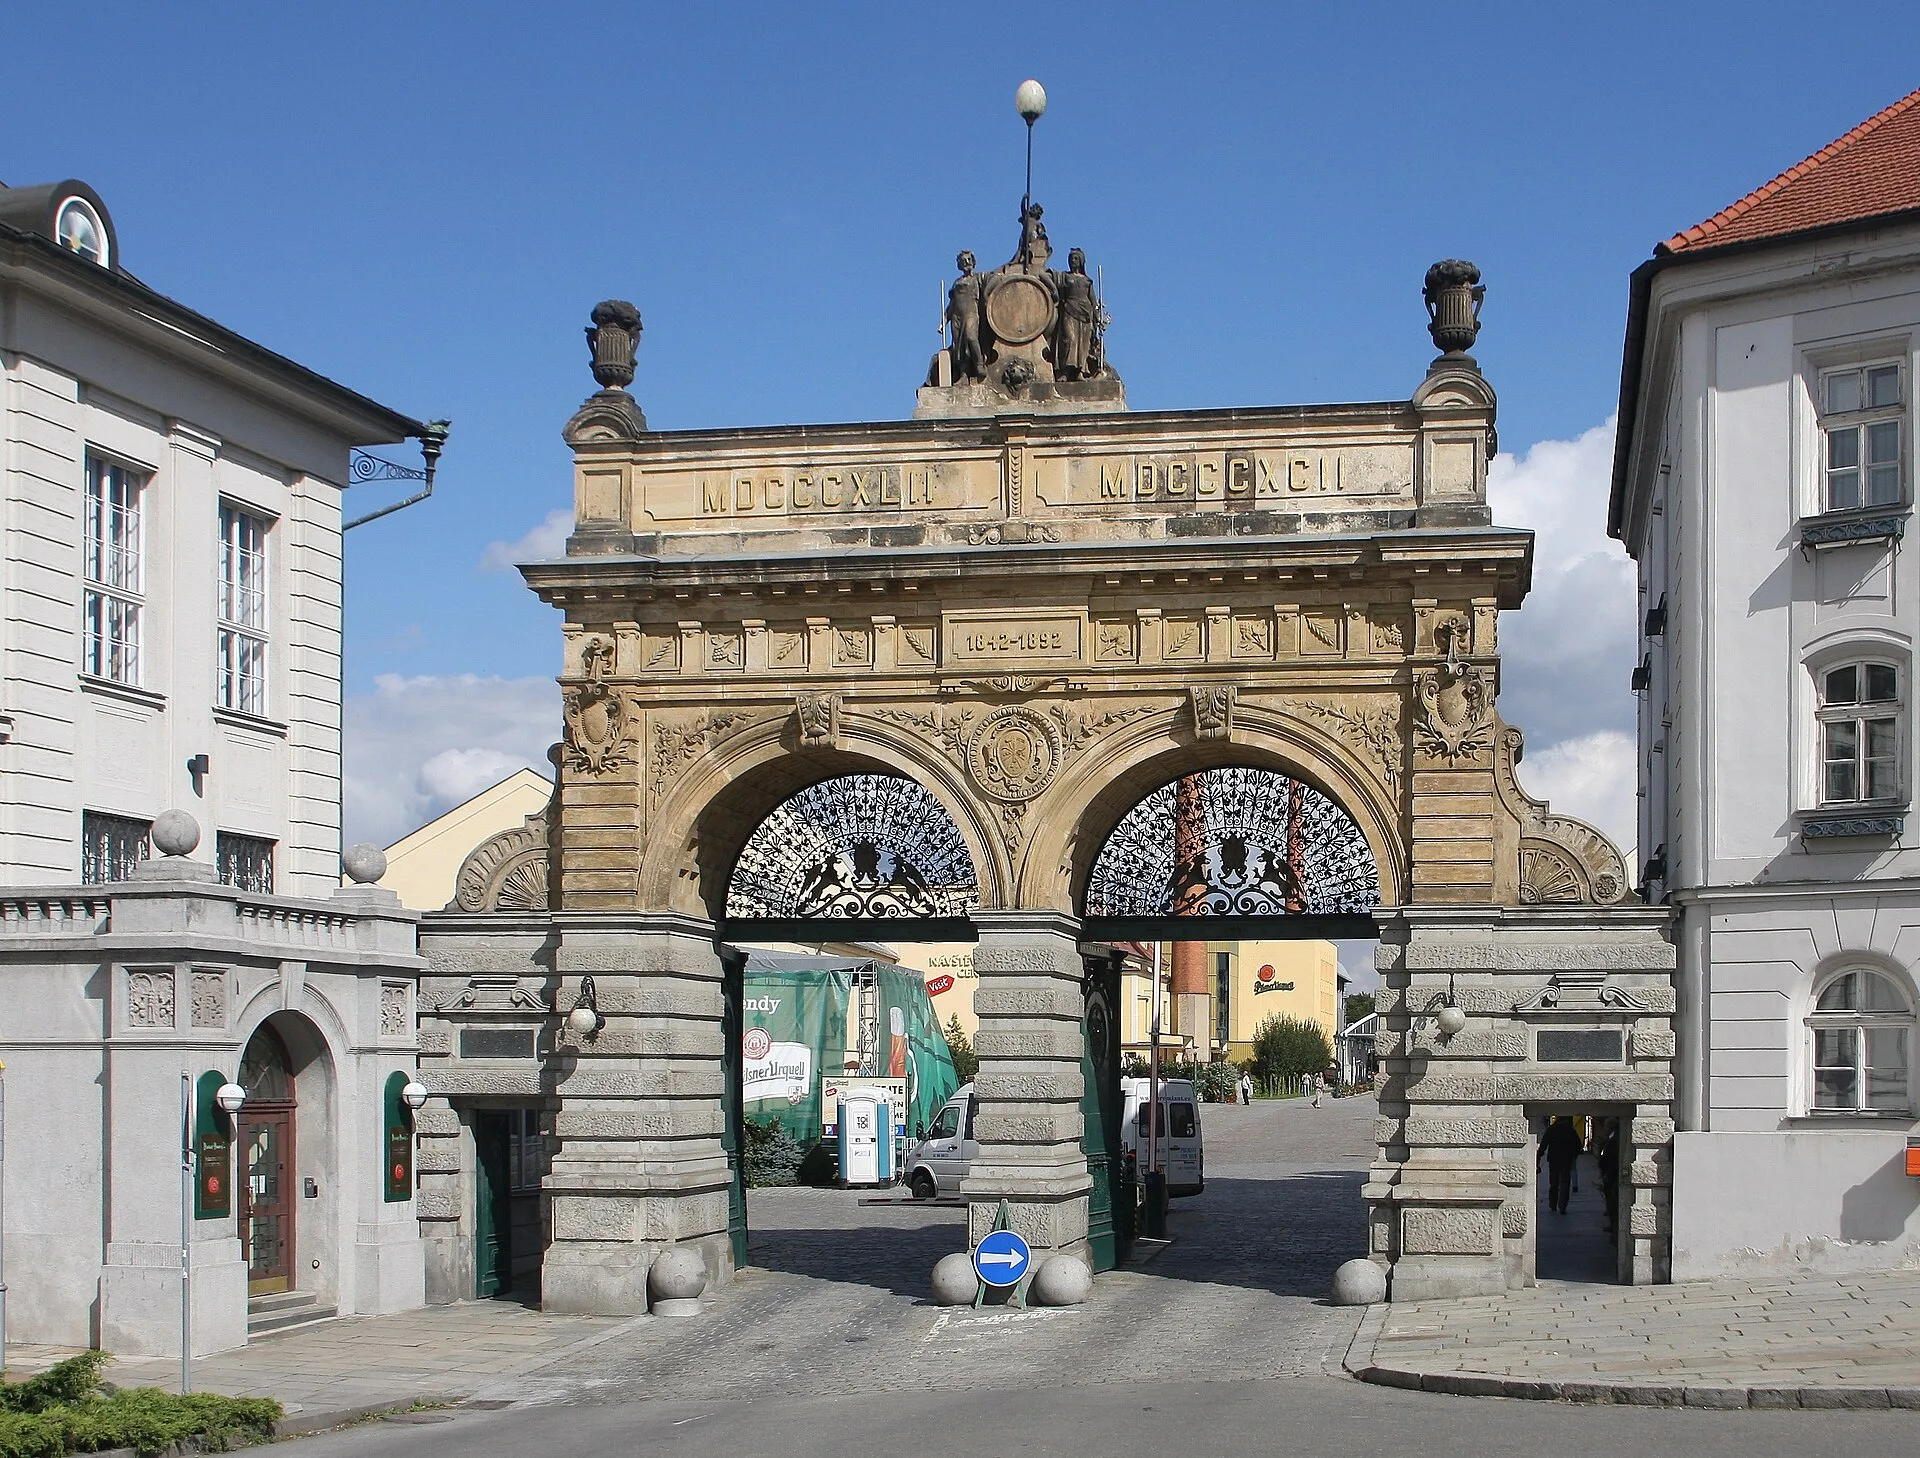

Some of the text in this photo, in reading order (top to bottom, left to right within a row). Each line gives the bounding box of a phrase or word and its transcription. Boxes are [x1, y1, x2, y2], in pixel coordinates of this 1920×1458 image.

[703, 471, 933, 513] MDCCCXLII
[1100, 454, 1346, 498] MDCCCXCII
[966, 631, 1063, 652] 1842-1892
[743, 1060, 805, 1082] ilsner Urquell
